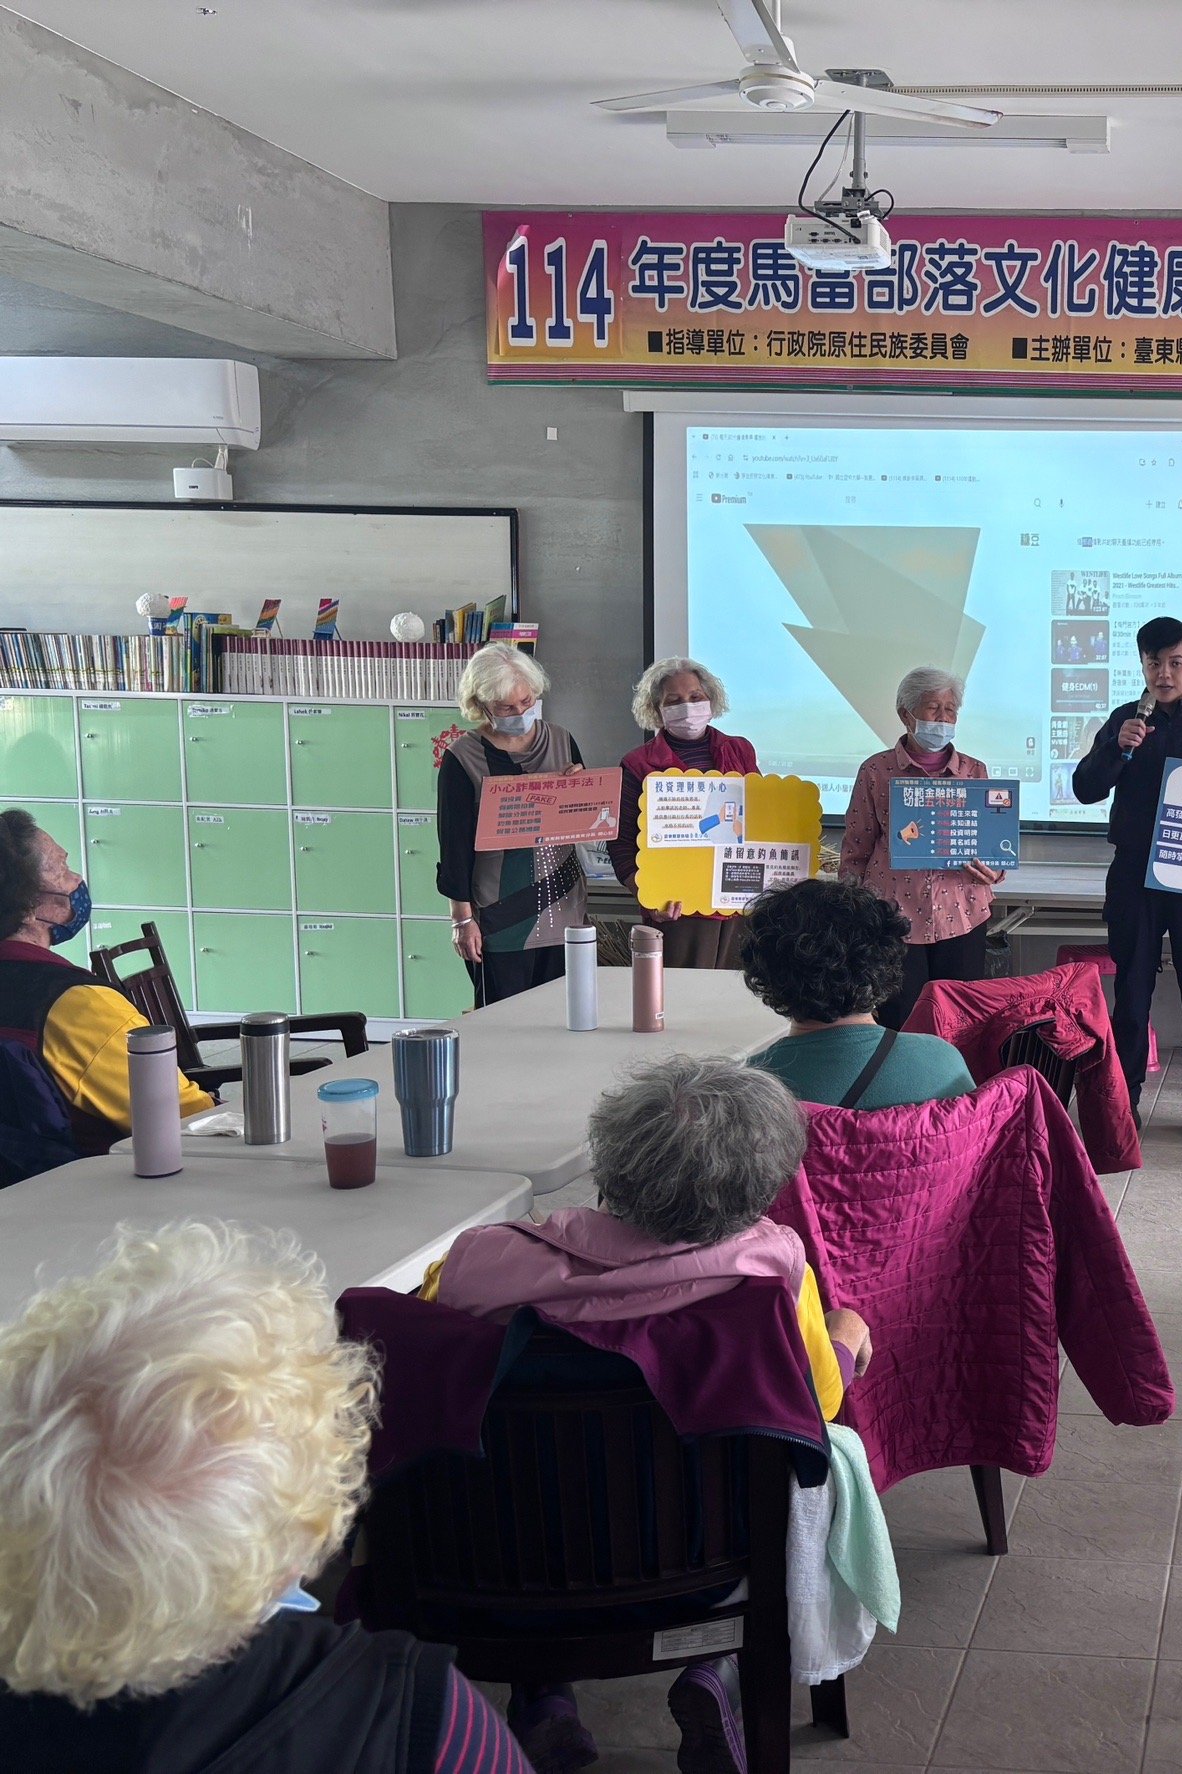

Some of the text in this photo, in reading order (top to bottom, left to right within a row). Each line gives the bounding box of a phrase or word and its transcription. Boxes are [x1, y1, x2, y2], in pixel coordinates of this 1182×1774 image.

[506, 238, 614, 345] 114
[666, 329, 970, 361] 指導單位：行政院原住民族委員會
[656, 781, 727, 793] 投資理財要小心
[903, 787, 967, 799] 防範金融詐騙
[529, 794, 553, 803] FAKE
[937, 810, 978, 818] 陌生來電
[937, 819, 978, 827] 未知連結
[937, 838, 978, 846] 莫名威脅
[723, 847, 800, 861] 請留意釣魚簡訊
[937, 848, 978, 856] 個人資料
